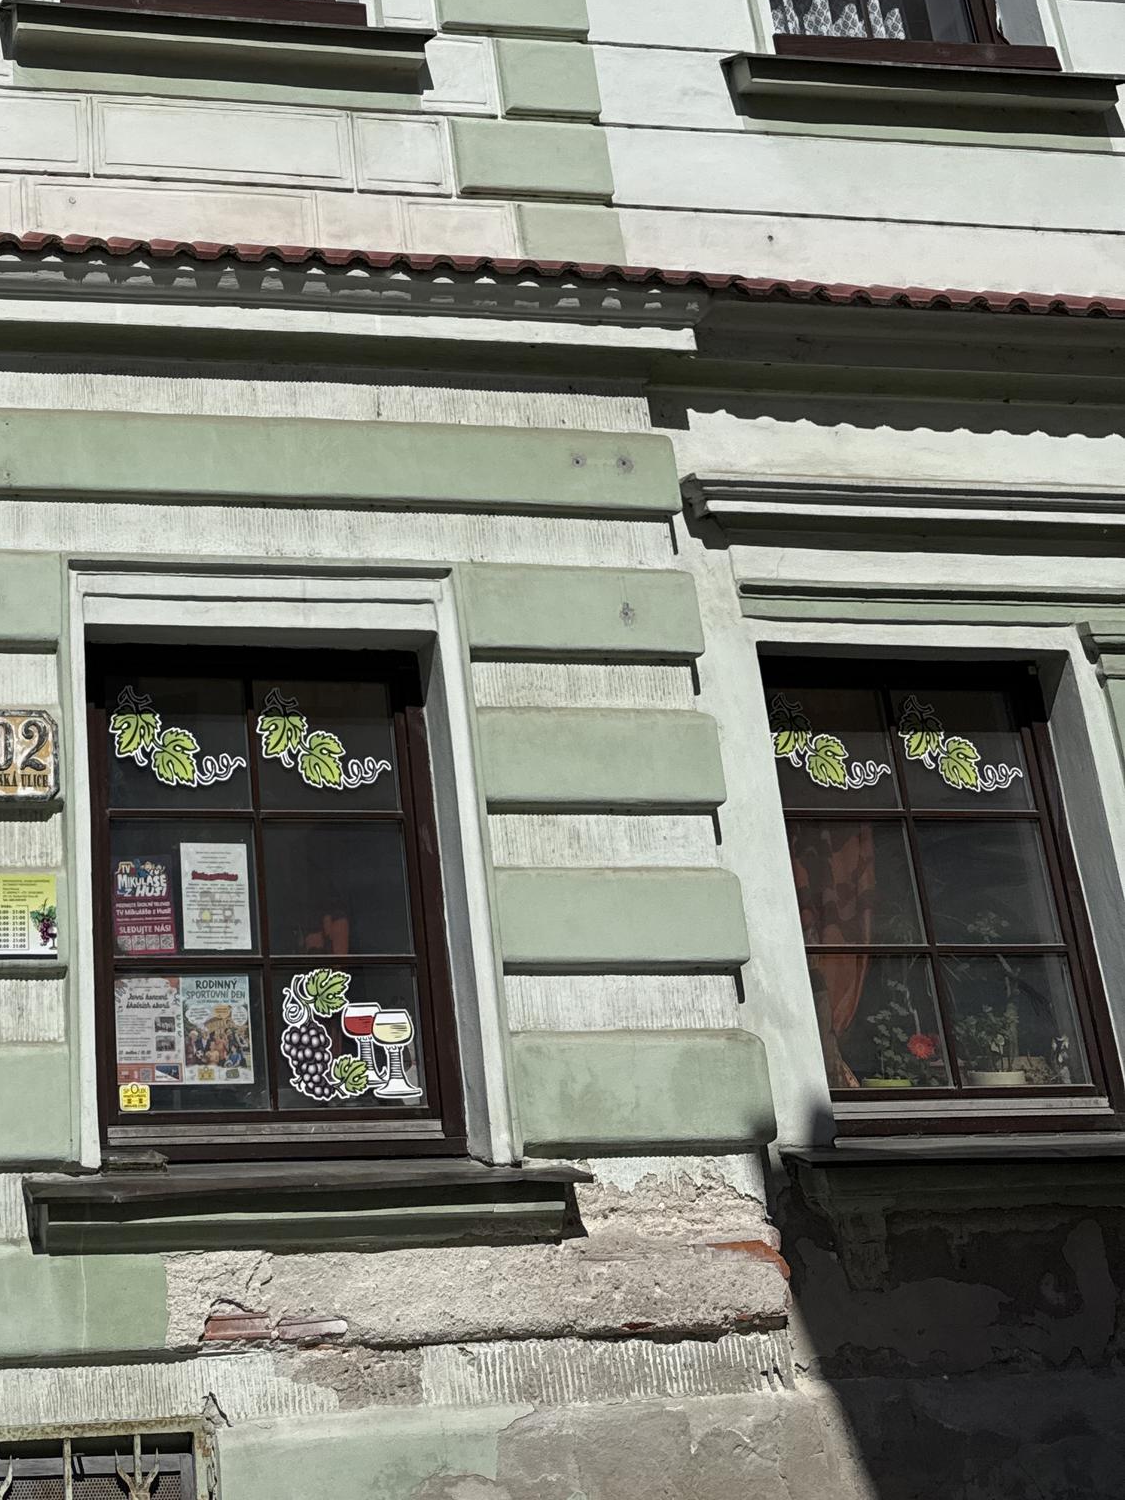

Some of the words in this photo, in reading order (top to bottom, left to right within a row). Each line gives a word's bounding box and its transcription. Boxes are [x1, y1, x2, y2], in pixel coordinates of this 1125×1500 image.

[21, 773, 50, 788] ULICE
[195, 978, 238, 990] RODINNÝ
[186, 989, 229, 1000] SPORTOVNÍ
